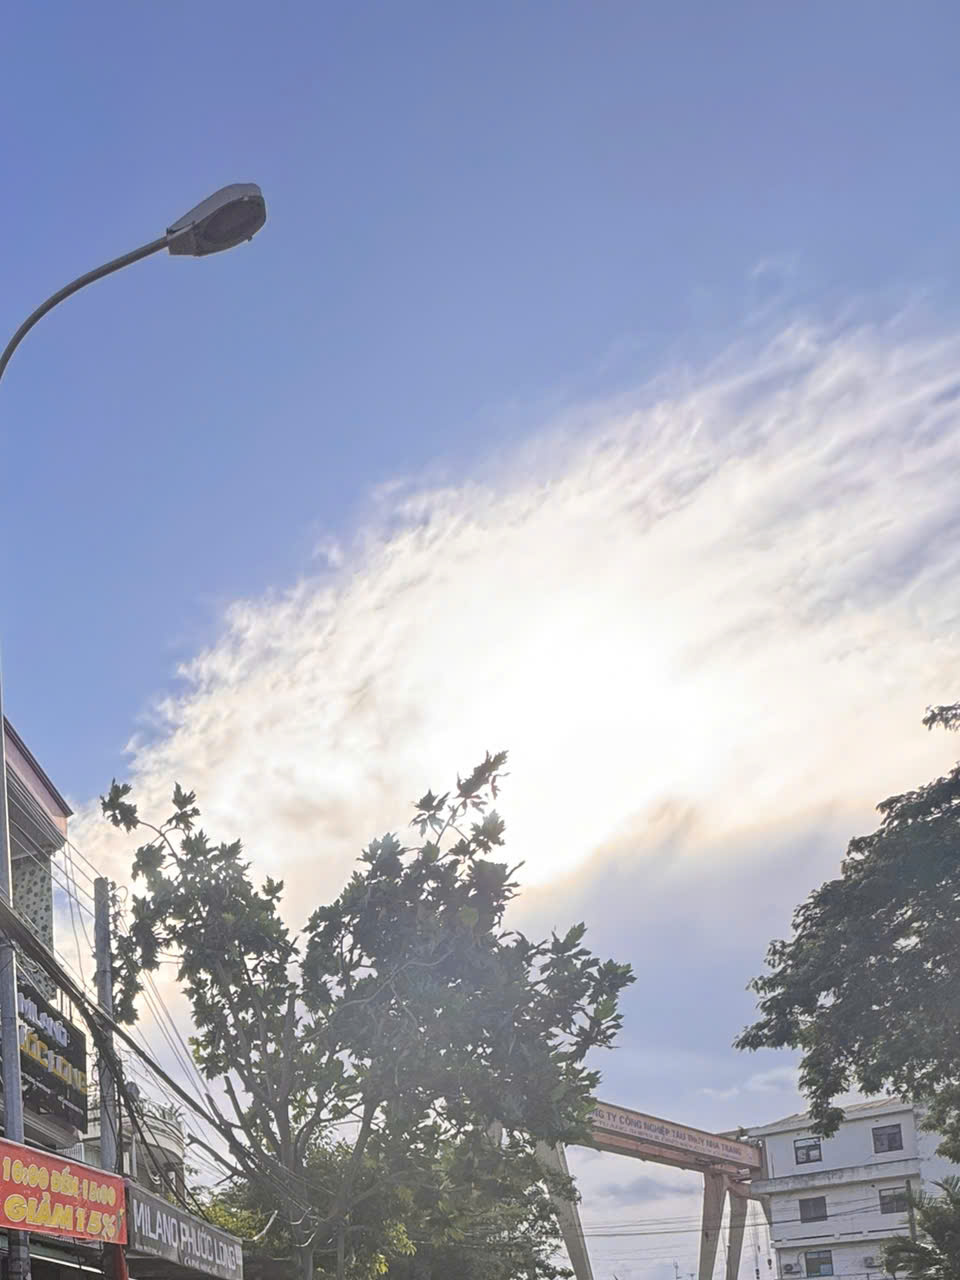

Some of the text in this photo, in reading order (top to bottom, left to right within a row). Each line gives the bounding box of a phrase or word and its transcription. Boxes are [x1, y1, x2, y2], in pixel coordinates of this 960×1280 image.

[4, 1191, 117, 1240] GIẢM 15%
[133, 1199, 178, 1248] MILANO
[180, 1224, 214, 1262] PHƯỚC
[214, 1238, 236, 1271] LONG
